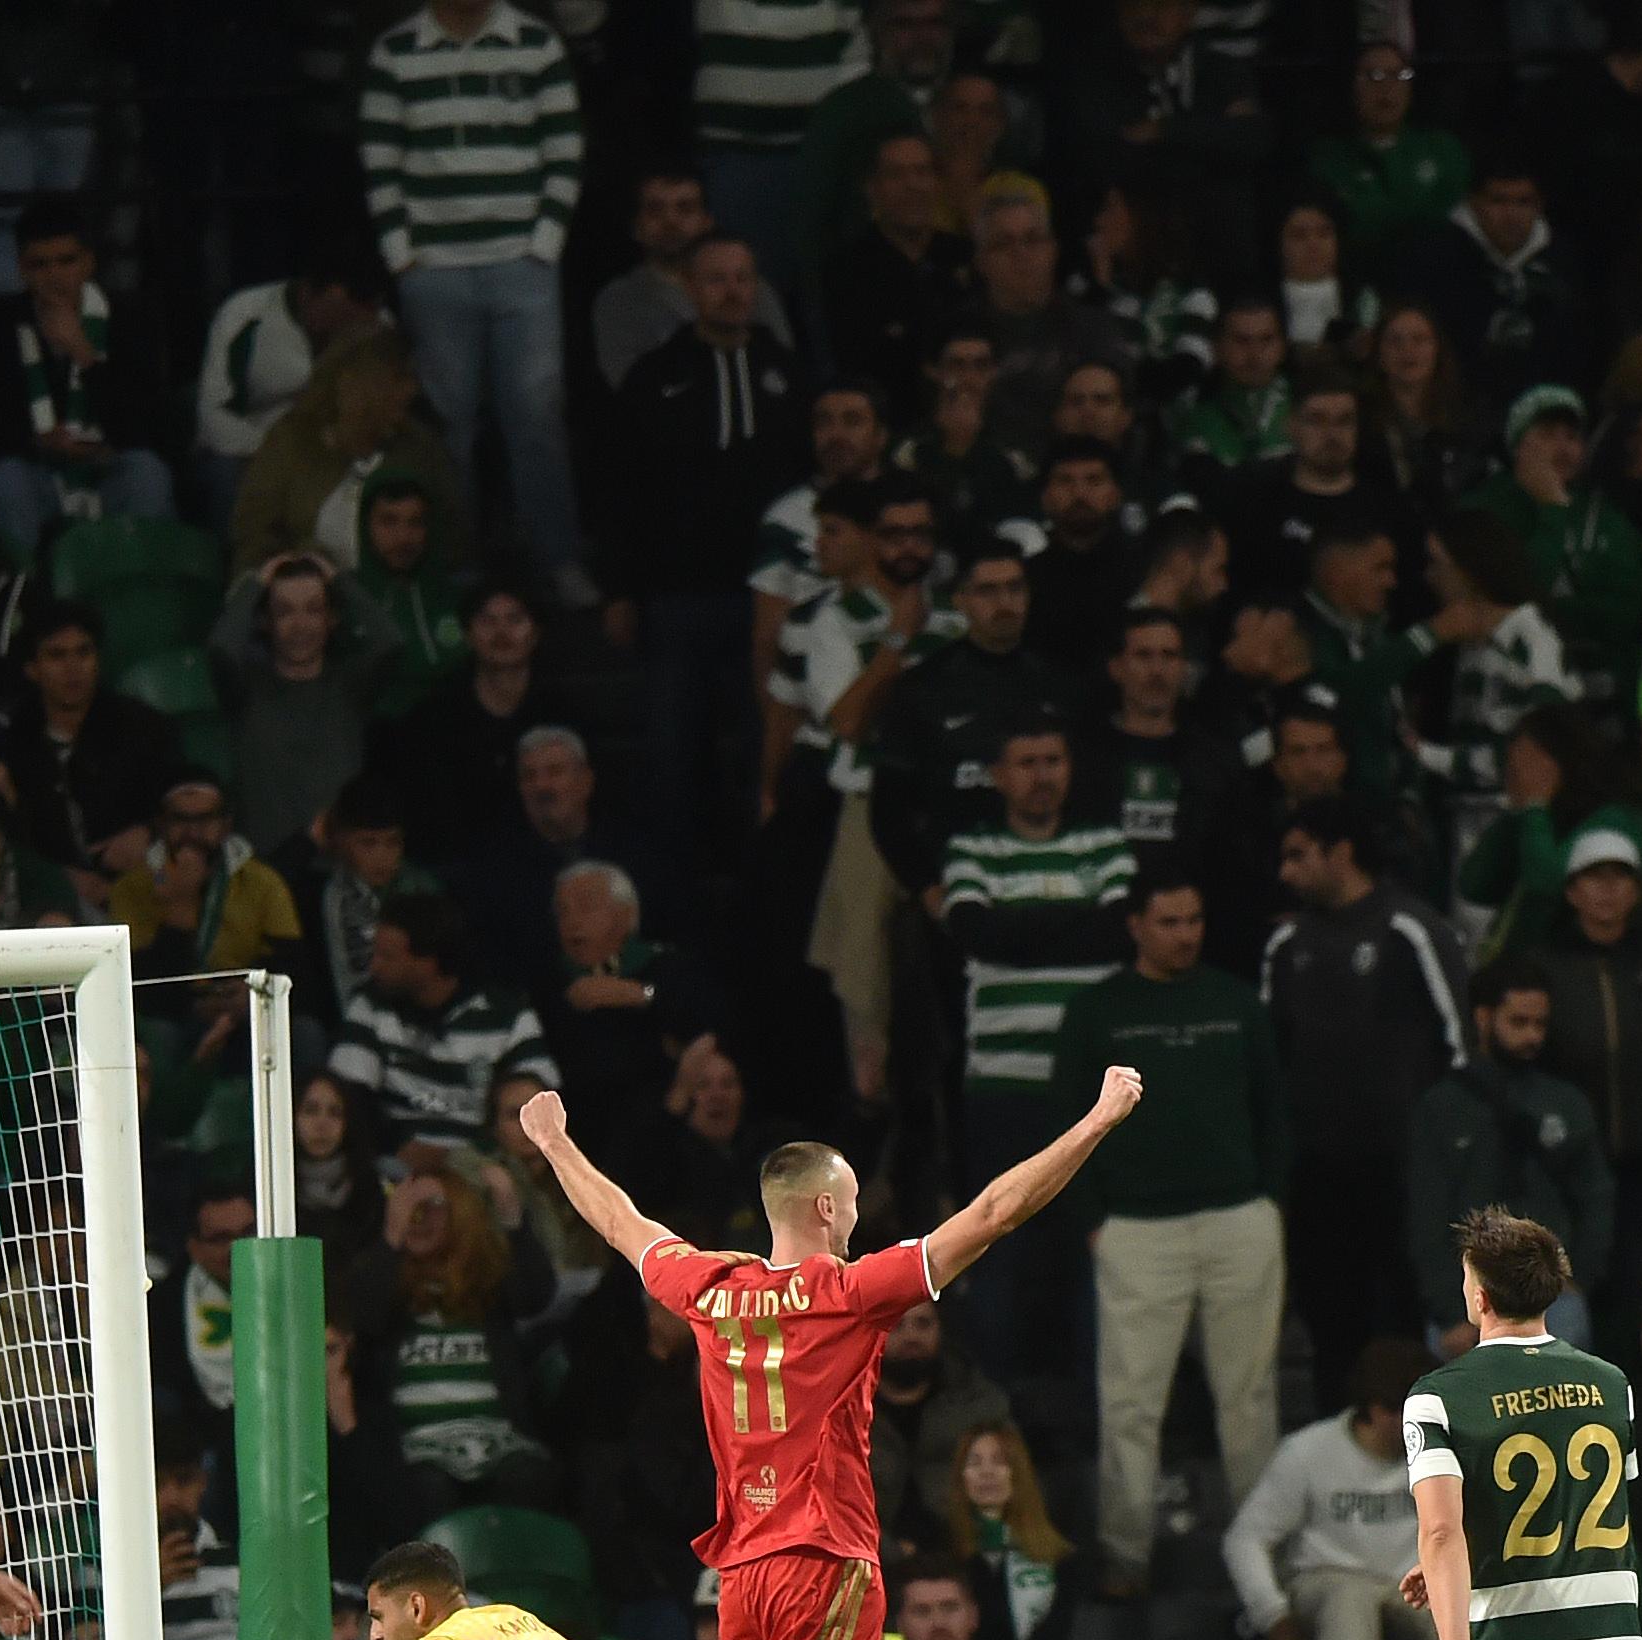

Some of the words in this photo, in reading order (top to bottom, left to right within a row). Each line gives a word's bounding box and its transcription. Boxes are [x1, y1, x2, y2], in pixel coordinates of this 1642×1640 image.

[713, 1315, 787, 1434] 11
[1491, 1383, 1605, 1420] FRESNEDA
[1492, 1422, 1631, 1564] 22
